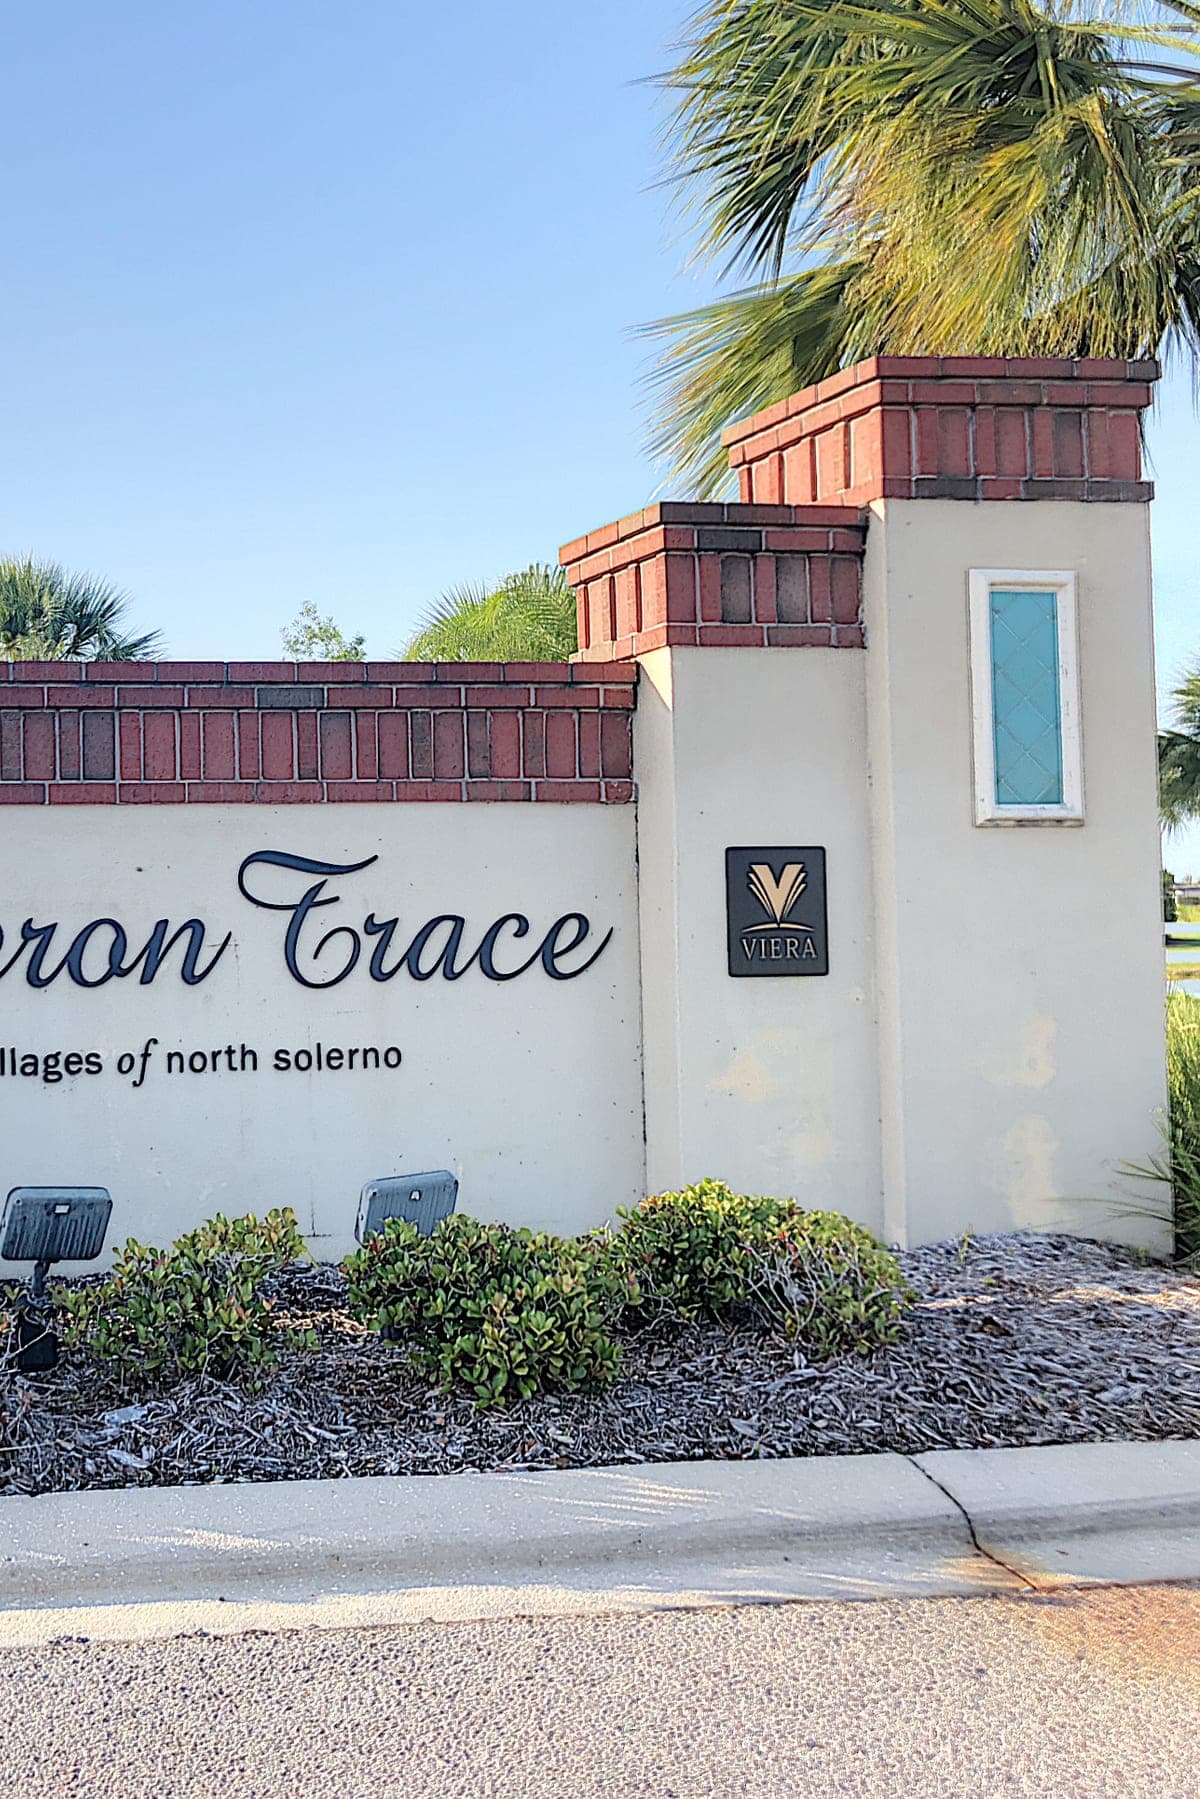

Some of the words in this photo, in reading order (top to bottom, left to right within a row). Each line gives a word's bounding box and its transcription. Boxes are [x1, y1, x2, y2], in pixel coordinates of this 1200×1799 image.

[237, 849, 615, 989] Trace
[741, 937, 817, 960] VIERA
[116, 1037, 158, 1087] of
[166, 1043, 258, 1074] north
[273, 1042, 401, 1072] solerno
